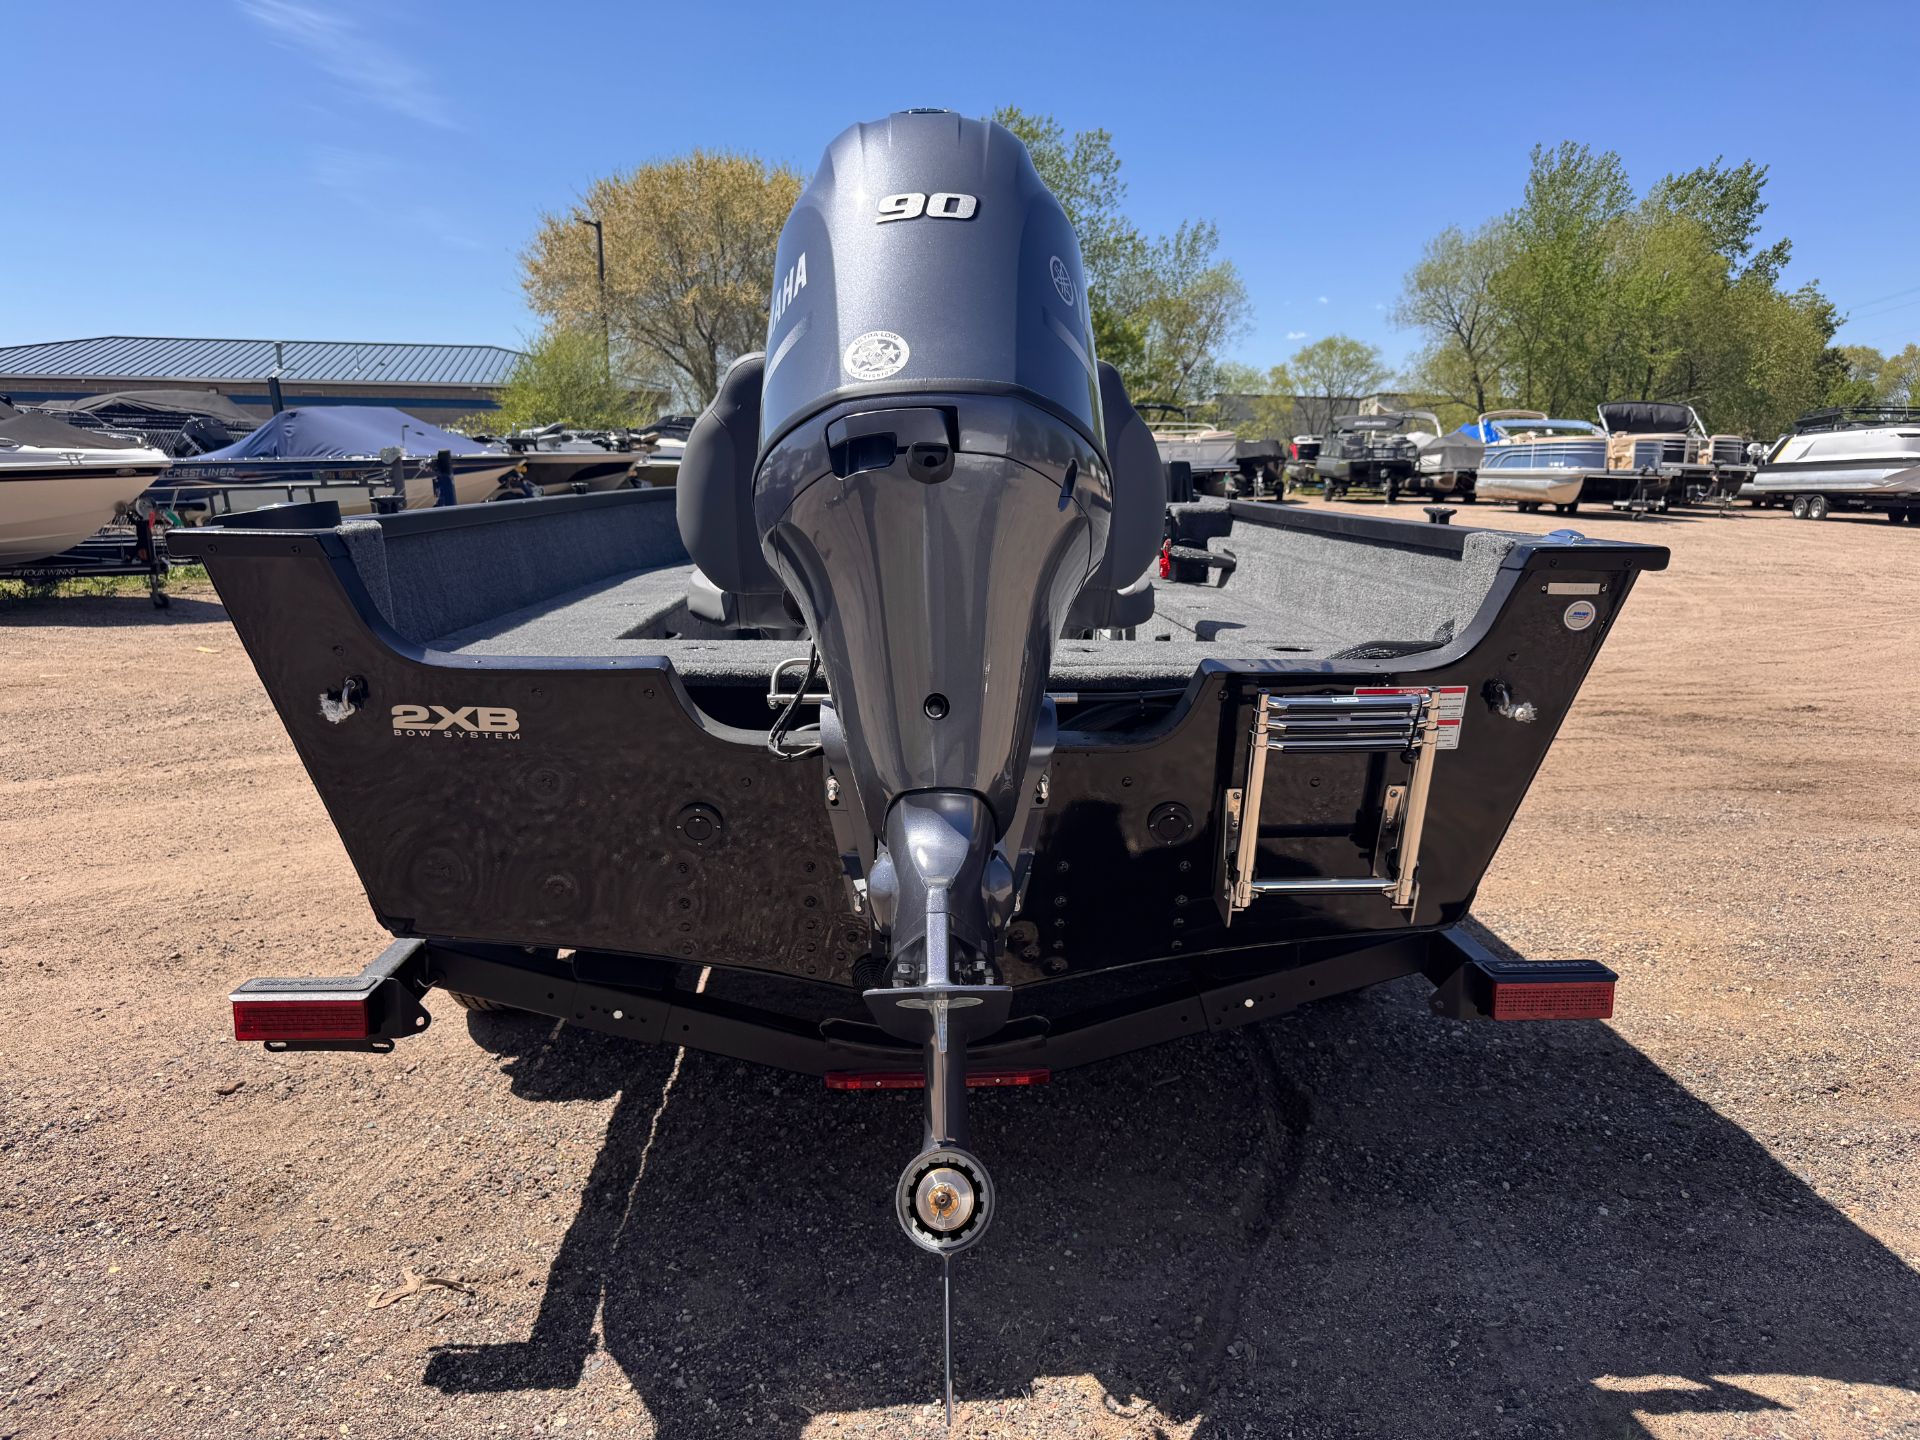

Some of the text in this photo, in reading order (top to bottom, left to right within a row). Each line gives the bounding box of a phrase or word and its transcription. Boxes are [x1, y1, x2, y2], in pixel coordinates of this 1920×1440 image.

[876, 192, 979, 224] 90
[880, 331, 900, 341] LOW
[166, 467, 235, 477] CRESTLINER
[22, 567, 76, 577] FOUR WINNS
[391, 704, 520, 732] 2XB
[393, 729, 521, 741] BOW SYSTEM
